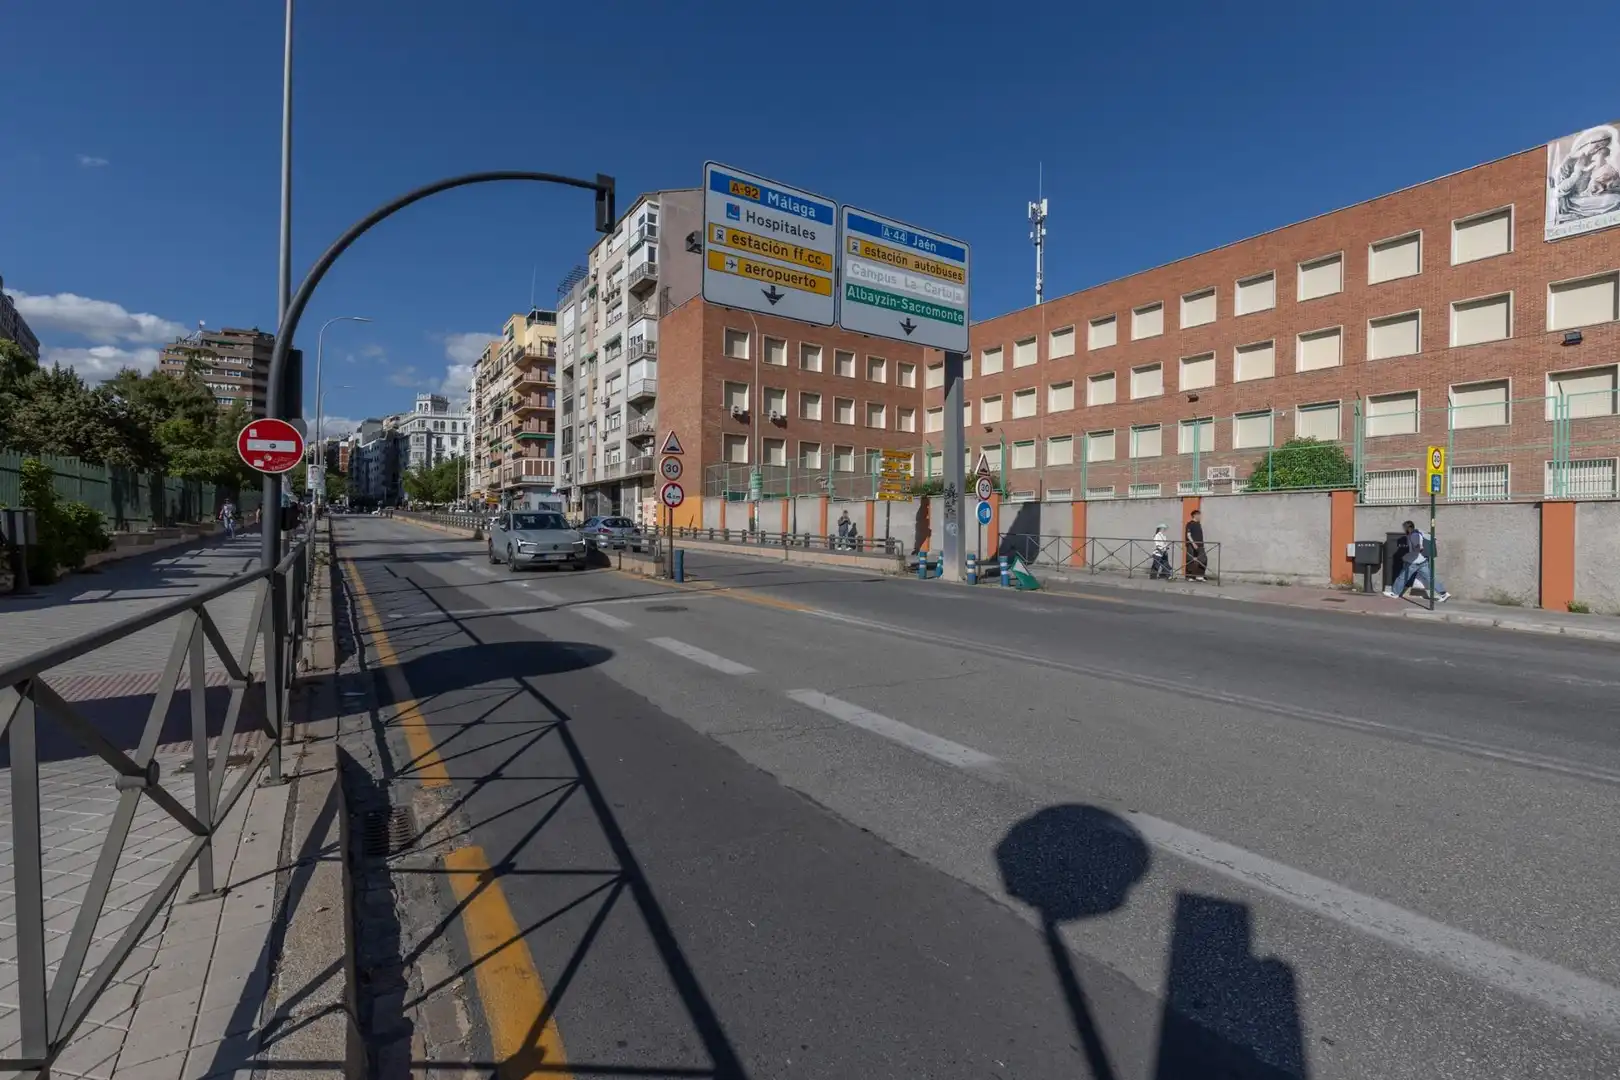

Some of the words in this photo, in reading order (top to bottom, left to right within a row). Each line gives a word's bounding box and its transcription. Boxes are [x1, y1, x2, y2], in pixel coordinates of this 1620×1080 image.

[731, 182, 759, 199] A-92
[767, 191, 816, 217] Málaga
[746, 210, 816, 240] Hospitales
[883, 228, 906, 243] A-44
[732, 233, 788, 257] estación
[912, 235, 937, 253] Jaén
[745, 262, 816, 288] aeropuerto
[864, 245, 908, 265] estación
[914, 260, 963, 281] autobuses
[851, 263, 897, 284] Campus
[904, 276, 917, 289] La
[665, 463, 679, 473] 30
